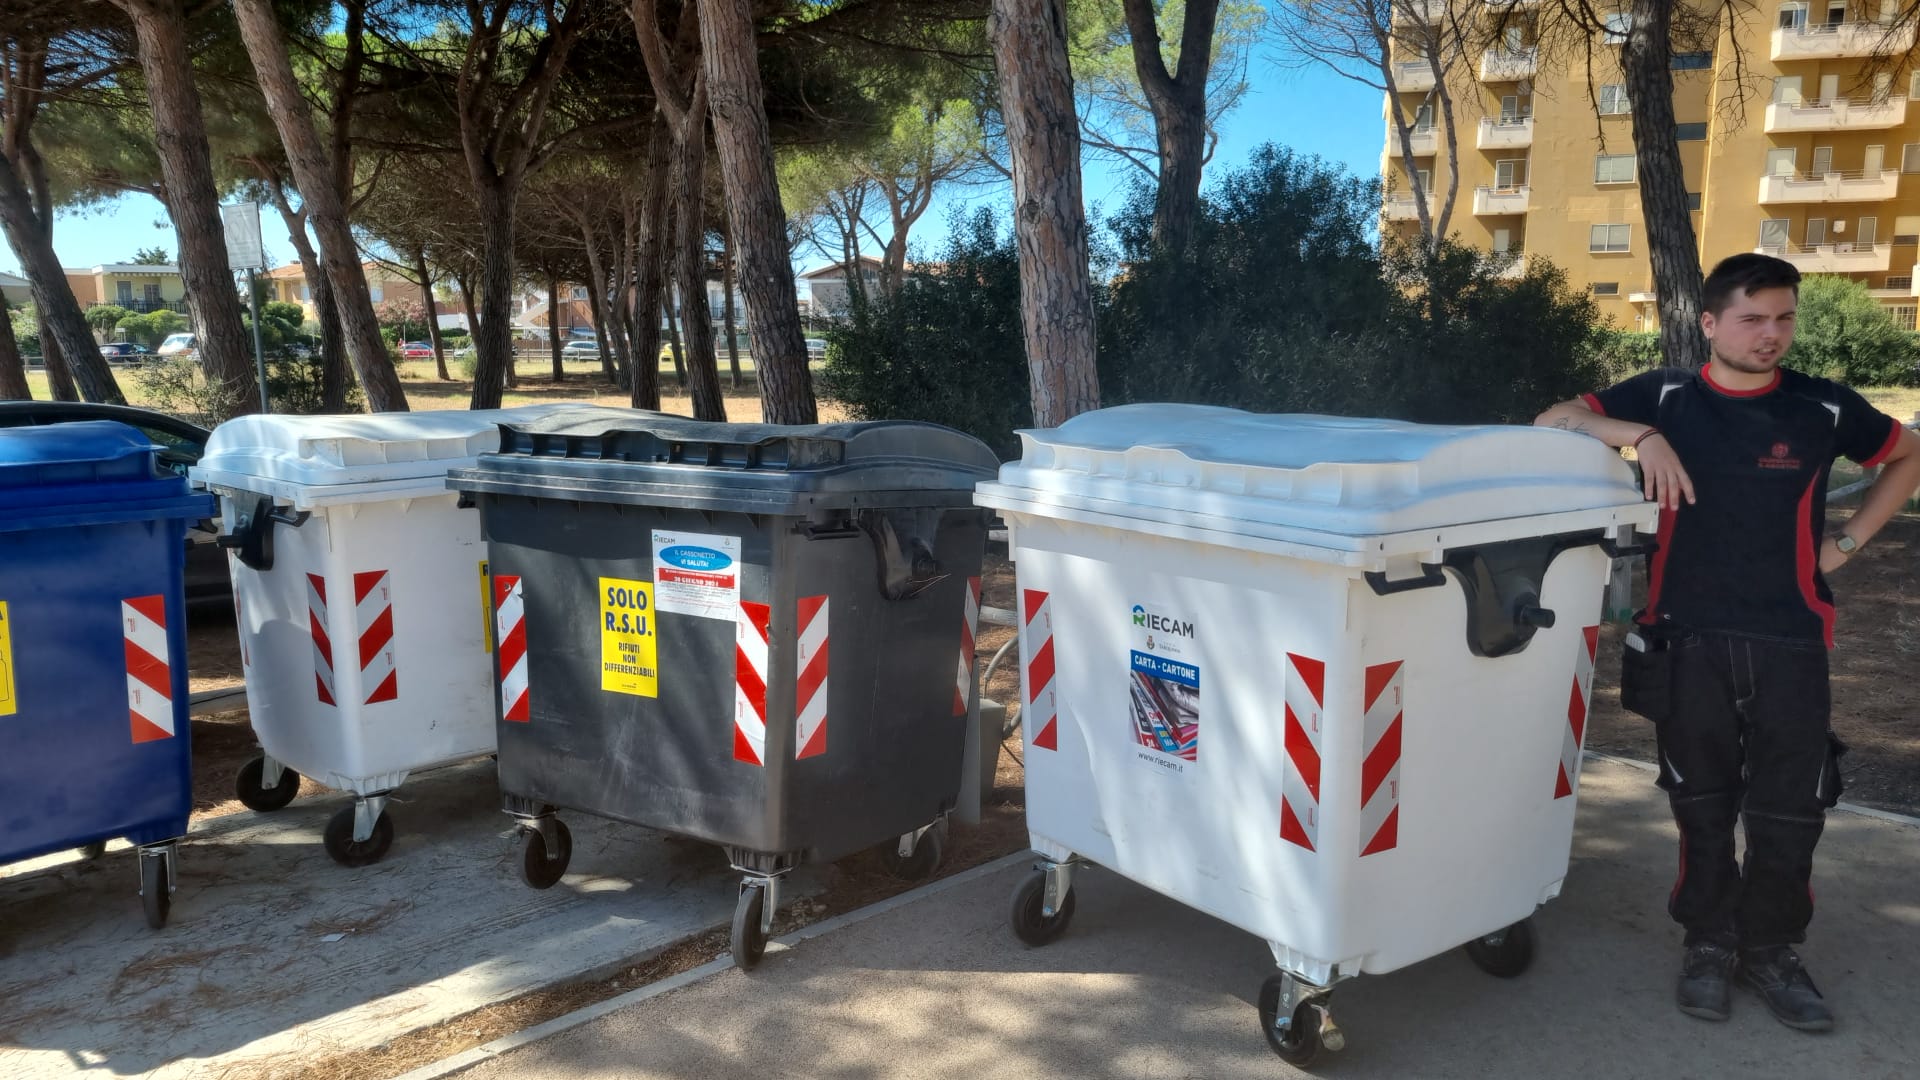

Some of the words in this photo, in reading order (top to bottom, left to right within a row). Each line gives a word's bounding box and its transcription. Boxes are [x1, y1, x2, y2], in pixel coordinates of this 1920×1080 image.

[680, 550, 716, 559] CASSONETTO
[607, 586, 647, 610] SOLO
[605, 611, 652, 637] R.S.U.
[1132, 604, 1194, 639] RIECAM
[618, 642, 640, 654] RIFIUTI
[622, 653, 636, 664] NON
[604, 662, 655, 678] DIFFERENZIABILI
[1134, 655, 1157, 671] CARTA
[1162, 662, 1196, 680] CARTONE
[1138, 752, 1183, 773] www.riecam.it
